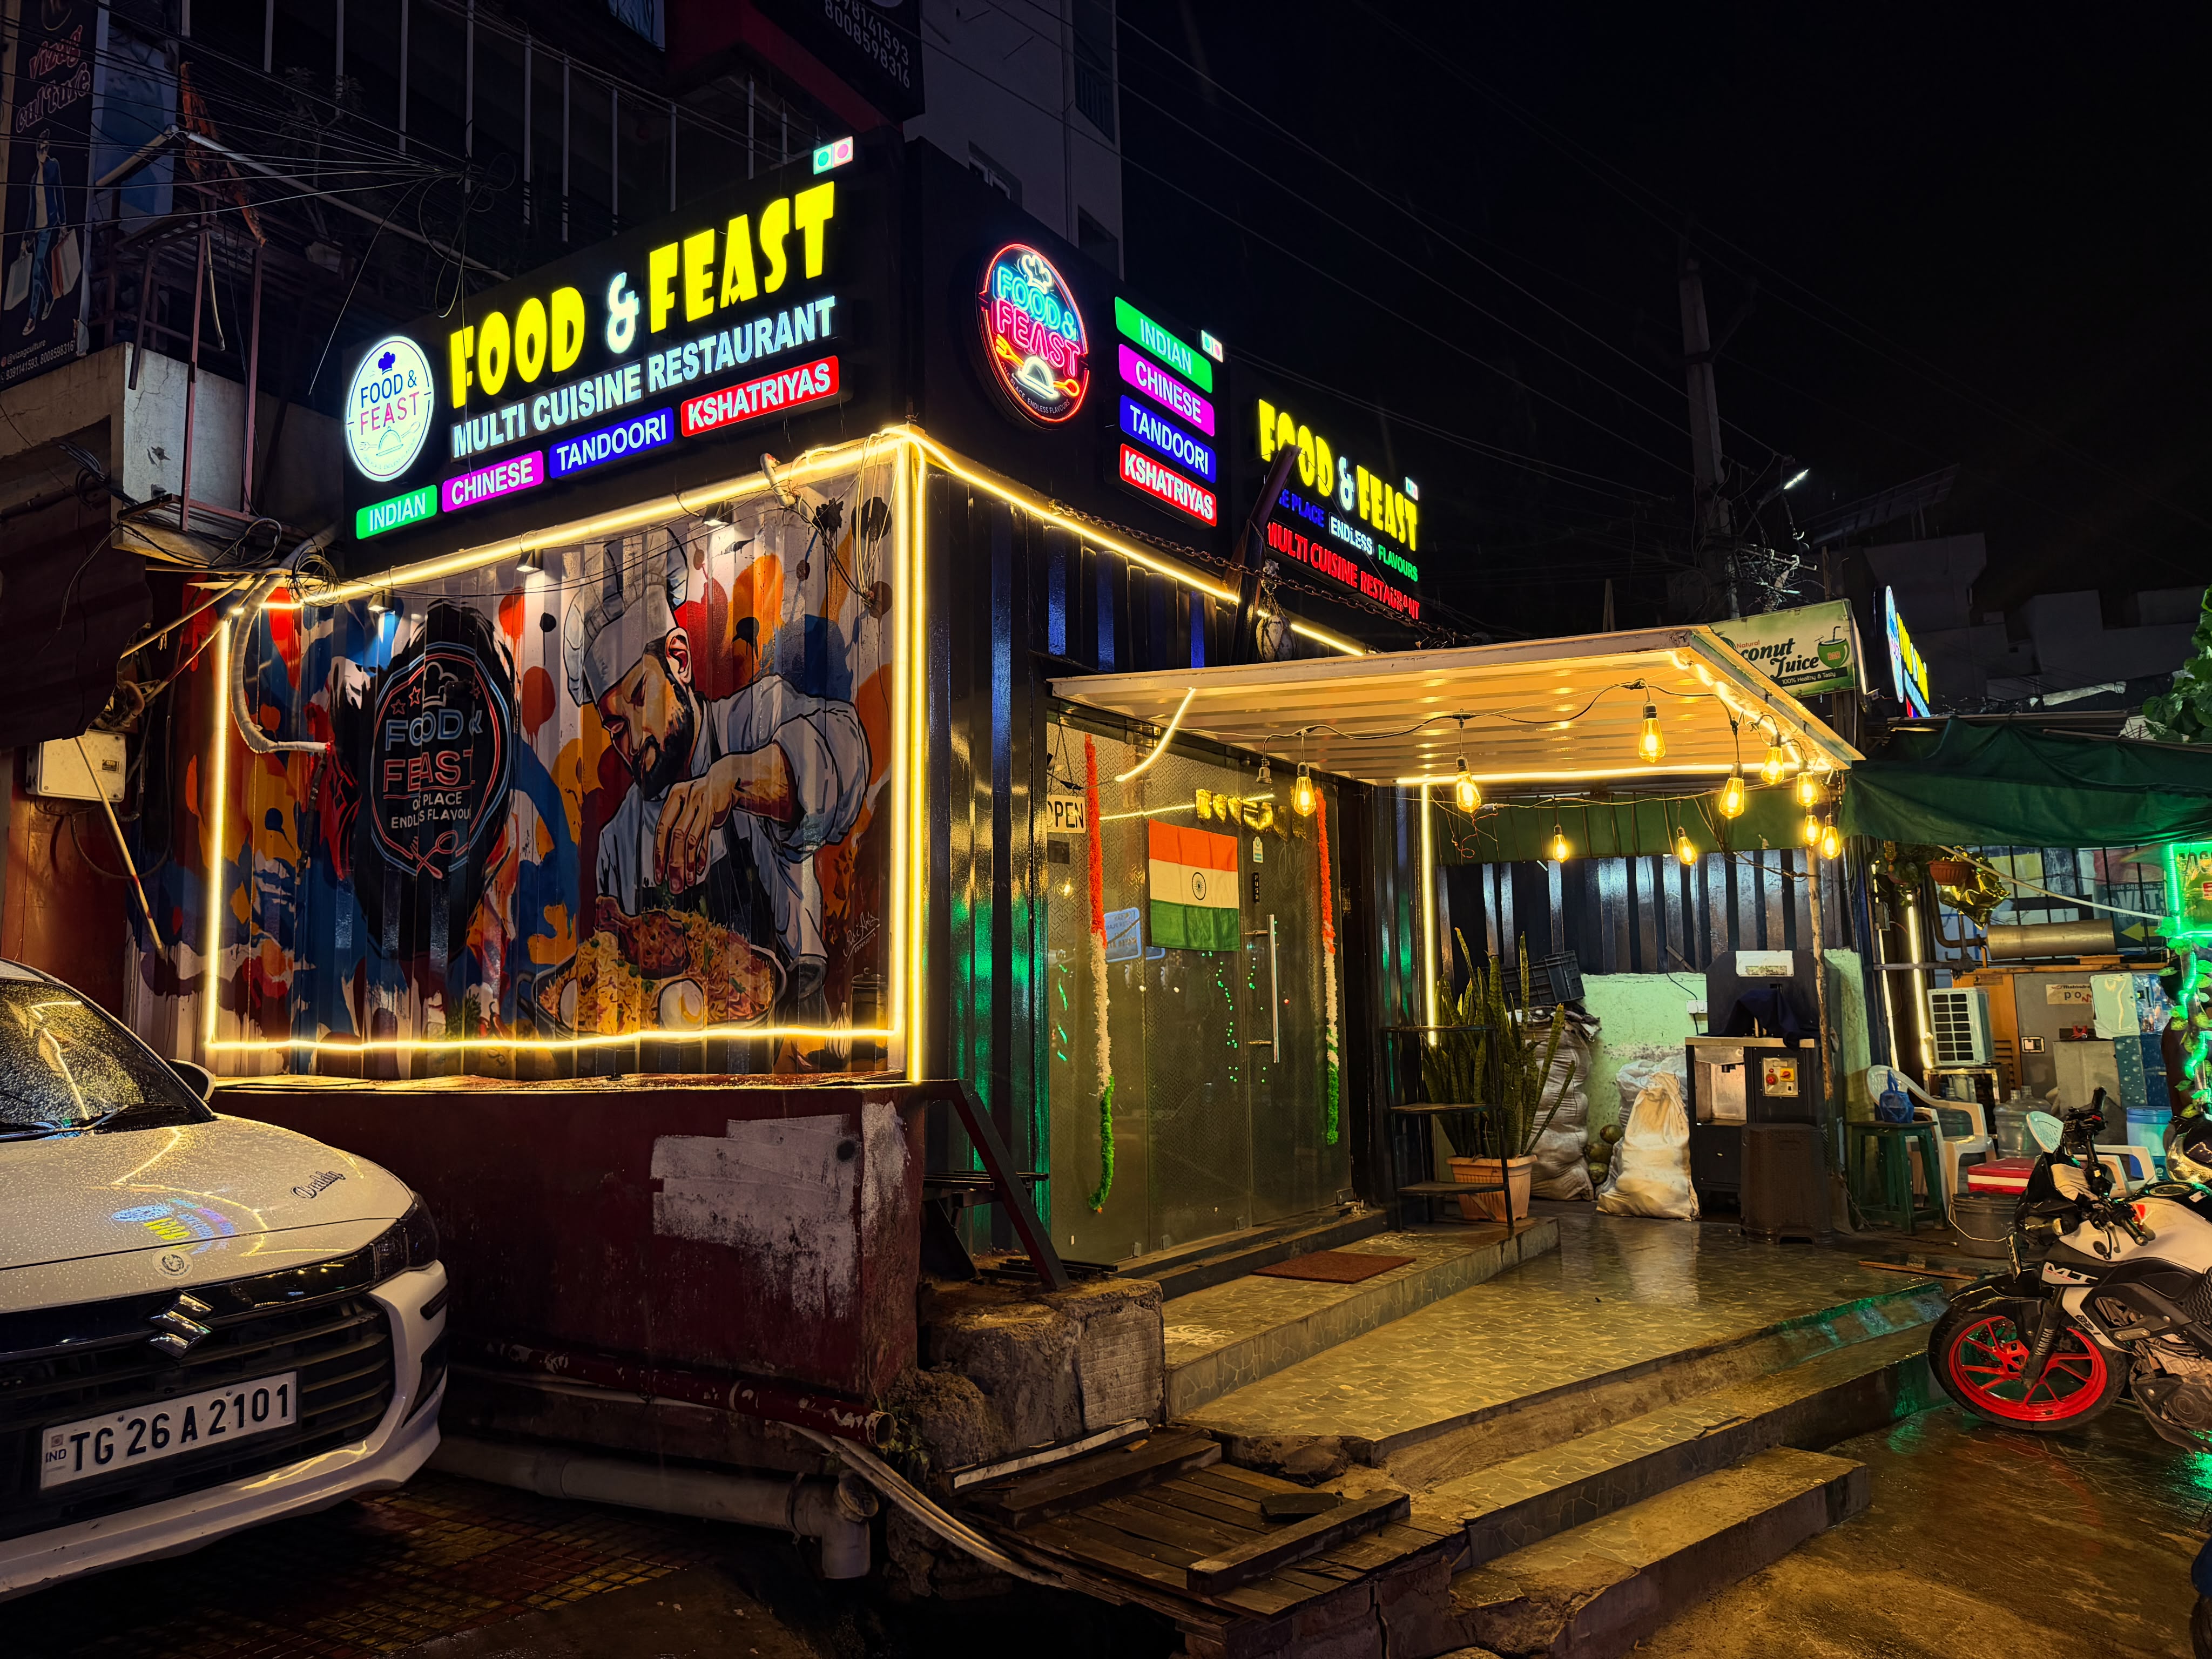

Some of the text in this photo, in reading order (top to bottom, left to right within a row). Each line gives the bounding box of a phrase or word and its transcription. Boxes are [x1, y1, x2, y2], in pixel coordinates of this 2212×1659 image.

[450, 180, 834, 409] FOOD & FEAST
[994, 265, 1078, 341] FOOD &
[993, 298, 1080, 377] FEAST
[1139, 317, 1192, 375] INDIAN
[361, 369, 417, 408] FOOD &
[453, 417, 527, 458] MULTI
[532, 363, 643, 432] CUISINE
[648, 295, 835, 393] RESTAURANT
[687, 364, 831, 431] KSHATRIYAS
[1136, 360, 1202, 424] CHINESE
[360, 391, 420, 435] FEAST
[1027, 397, 1049, 414] ENDLESS
[1049, 399, 1070, 414] FLAVOURS
[556, 414, 667, 471] TANDOORI
[1130, 404, 1209, 475] TANDOORI
[451, 457, 534, 505] CHINESE
[1124, 449, 1213, 520] KSHATRIYAS
[1259, 399, 1418, 551] FOOD & FEAST
[369, 492, 426, 532] INDIAN
[1291, 493, 1325, 528] PLACE
[1331, 515, 1373, 556] ENDLESS
[1378, 544, 1418, 583] FLAVOURS
[1267, 522, 1308, 563] MULTI
[1310, 543, 1358, 589] CUISINE
[1736, 639, 1761, 649] Natural
[1769, 655, 1819, 679] Juice
[1827, 651, 1842, 661] BAR
[1782, 677, 1797, 685] 100%
[1797, 674, 1816, 683] Healthy
[385, 709, 464, 751] FOOD
[423, 791, 462, 806] PLACE
[2034, 1327, 2055, 1357] YAMAHA
[45, 1448, 67, 1463] IND
[70, 1384, 289, 1472] TG 26 A 2101
